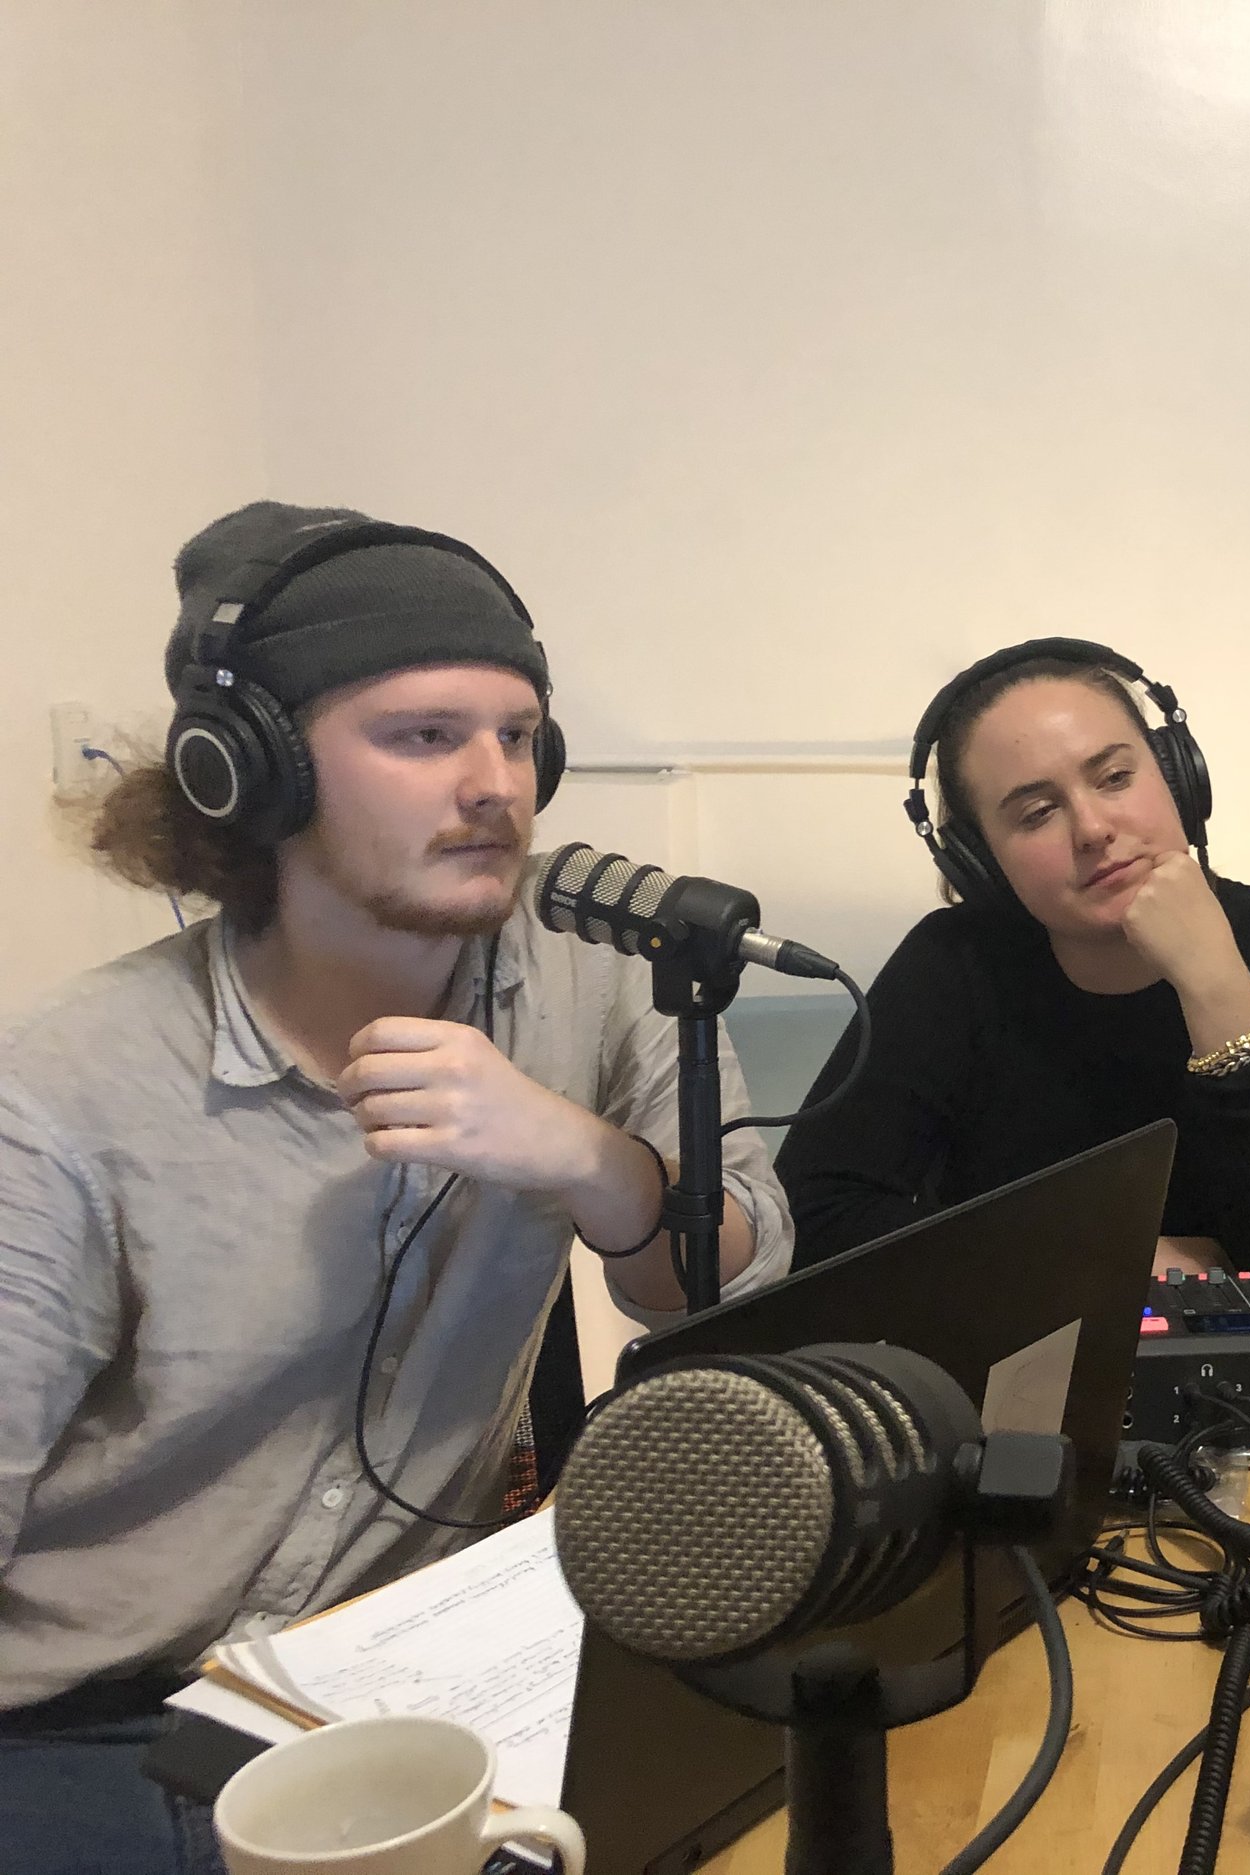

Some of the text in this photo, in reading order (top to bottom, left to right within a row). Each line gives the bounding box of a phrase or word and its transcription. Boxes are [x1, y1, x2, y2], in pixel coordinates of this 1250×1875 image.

[1173, 1386, 1179, 1395] 1
[1235, 1383, 1242, 1392] 3
[1173, 1415, 1180, 1423] 2
